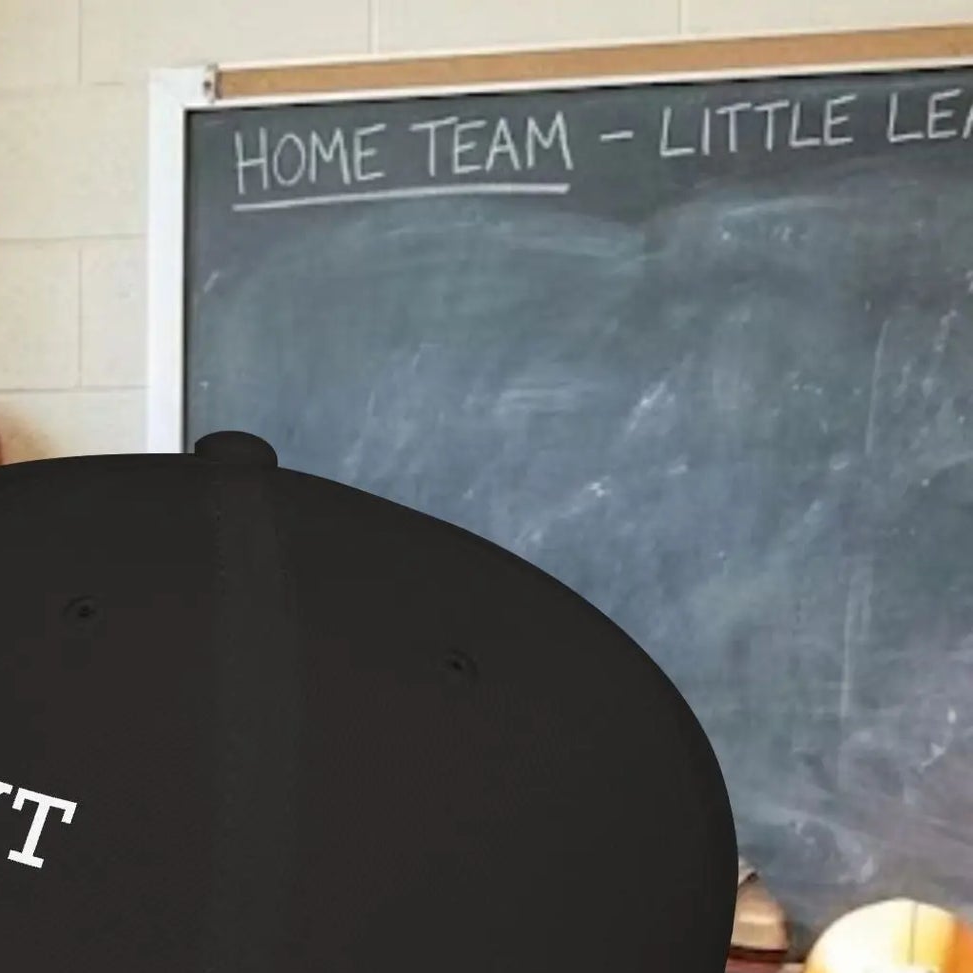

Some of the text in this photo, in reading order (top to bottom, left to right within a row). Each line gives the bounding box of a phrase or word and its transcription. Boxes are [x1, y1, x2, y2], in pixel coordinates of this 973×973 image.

[235, 123, 387, 195] HOME
[409, 110, 574, 177] TEAM
[660, 93, 857, 158] LITTLE
